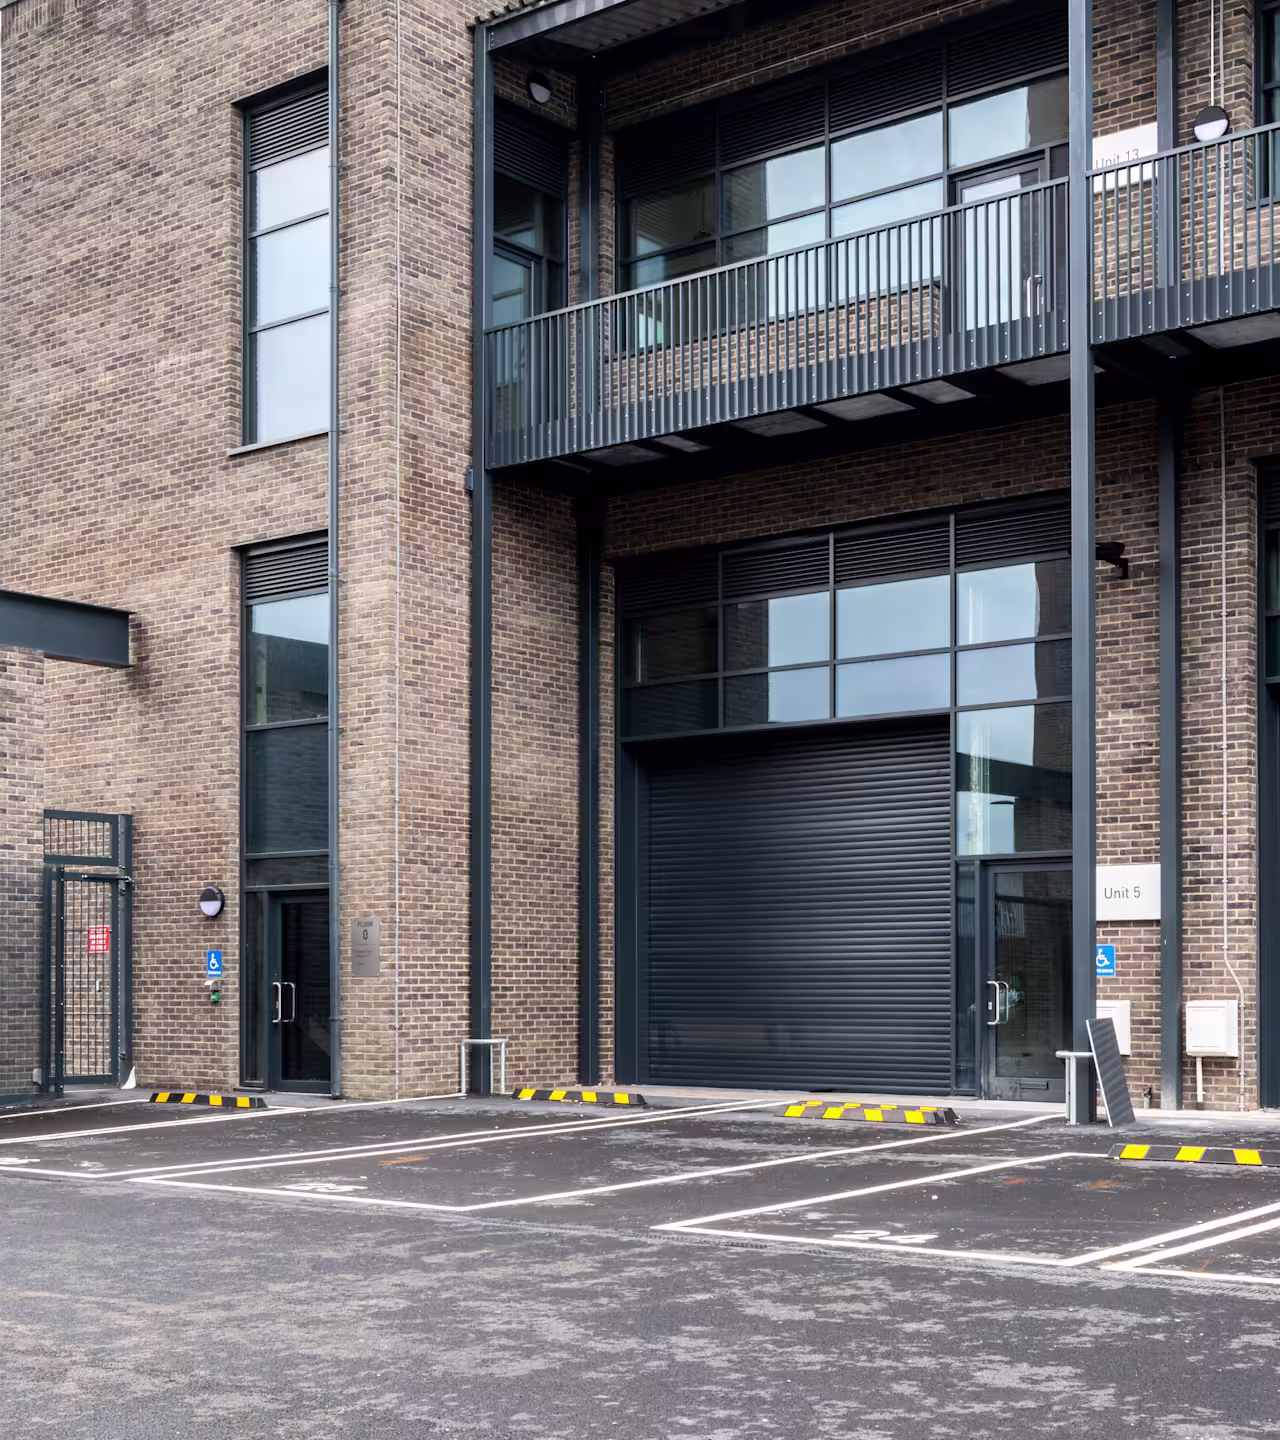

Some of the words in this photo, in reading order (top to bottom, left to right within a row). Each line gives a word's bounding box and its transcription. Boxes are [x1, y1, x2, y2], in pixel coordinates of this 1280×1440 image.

[1125, 148, 1140, 162] 13
[1104, 886, 1130, 900] Unit
[1133, 885, 1141, 899] 5
[832, 1229, 939, 1244] 24
